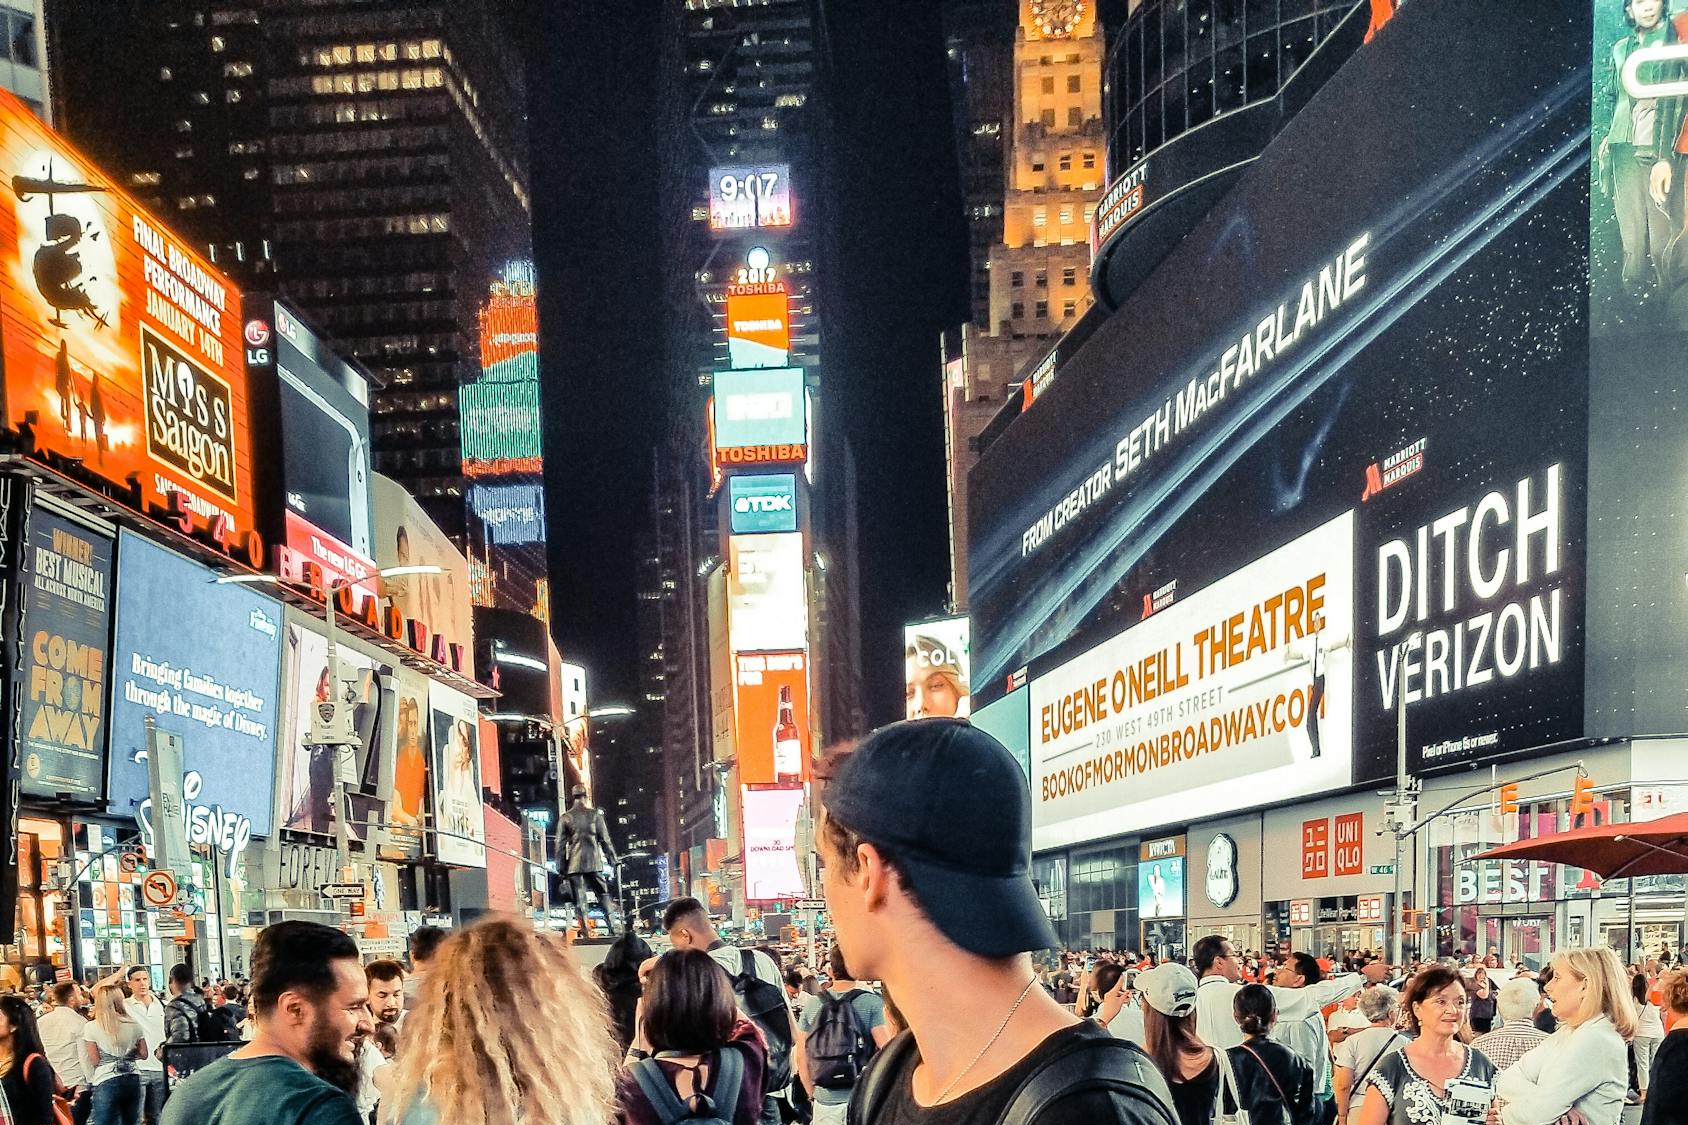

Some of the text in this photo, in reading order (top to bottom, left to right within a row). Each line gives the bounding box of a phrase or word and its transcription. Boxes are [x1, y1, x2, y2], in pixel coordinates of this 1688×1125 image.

[720, 173, 778, 201] 9:07
[1098, 162, 1147, 221] MARRIOTT
[1098, 191, 1139, 240] MARQUIS
[132, 214, 226, 313] FINAL BROADWAY
[728, 282, 785, 295] TOSHIBA
[143, 254, 222, 338] PERFORMANCE
[146, 288, 224, 368] JANUARY 14TH
[247, 349, 268, 364] LG
[152, 393, 232, 487] Saigon
[717, 444, 805, 463] TOSHIBA
[1384, 437, 1427, 471] MARRIOTT
[1022, 509, 1053, 557] FROM
[1054, 462, 1112, 530] CREATOR
[1115, 400, 1172, 481] SETH
[1384, 456, 1421, 486] MARQUIS
[748, 495, 792, 513] TDK
[35, 546, 105, 599] BEST MUSICAL
[311, 534, 329, 561] The
[1378, 462, 1561, 637] DITCH
[33, 630, 103, 683] COME
[1041, 572, 1327, 746] EUGENE O'NEILL THEATRE
[1377, 587, 1561, 710] VERIZON
[31, 665, 102, 717] FROM
[131, 652, 264, 713] Bringing families together
[28, 704, 100, 751] AWAY
[125, 680, 268, 742] through the magic of Disney.
[1095, 686, 1224, 749] 230 WEST 49TH STREET
[1337, 820, 1359, 844] UNI
[1337, 846, 1360, 872] QLO
